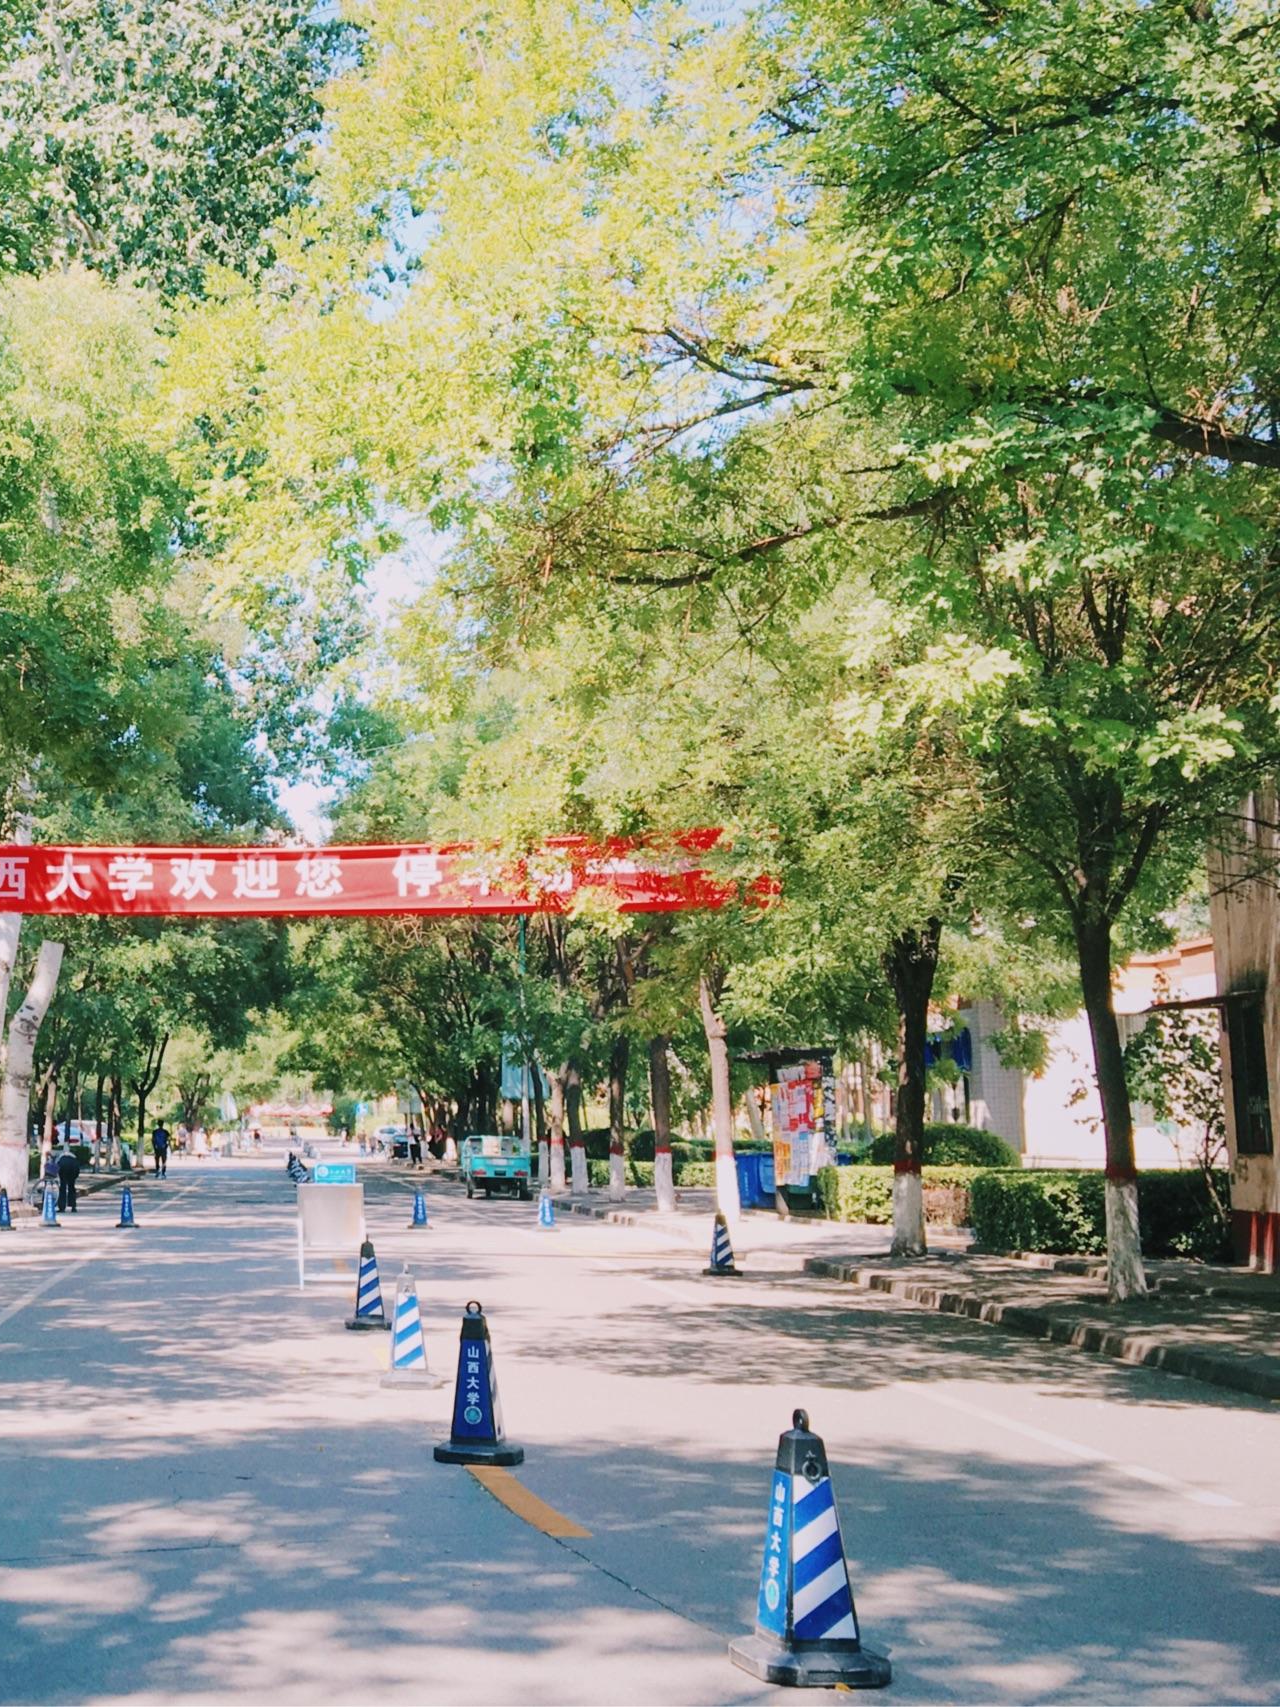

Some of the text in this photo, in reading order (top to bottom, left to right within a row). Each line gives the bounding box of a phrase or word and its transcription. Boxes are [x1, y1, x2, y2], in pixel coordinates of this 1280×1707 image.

[466, 1345, 480, 1405] 山西大学
[768, 1481, 786, 1577] 山西大学
